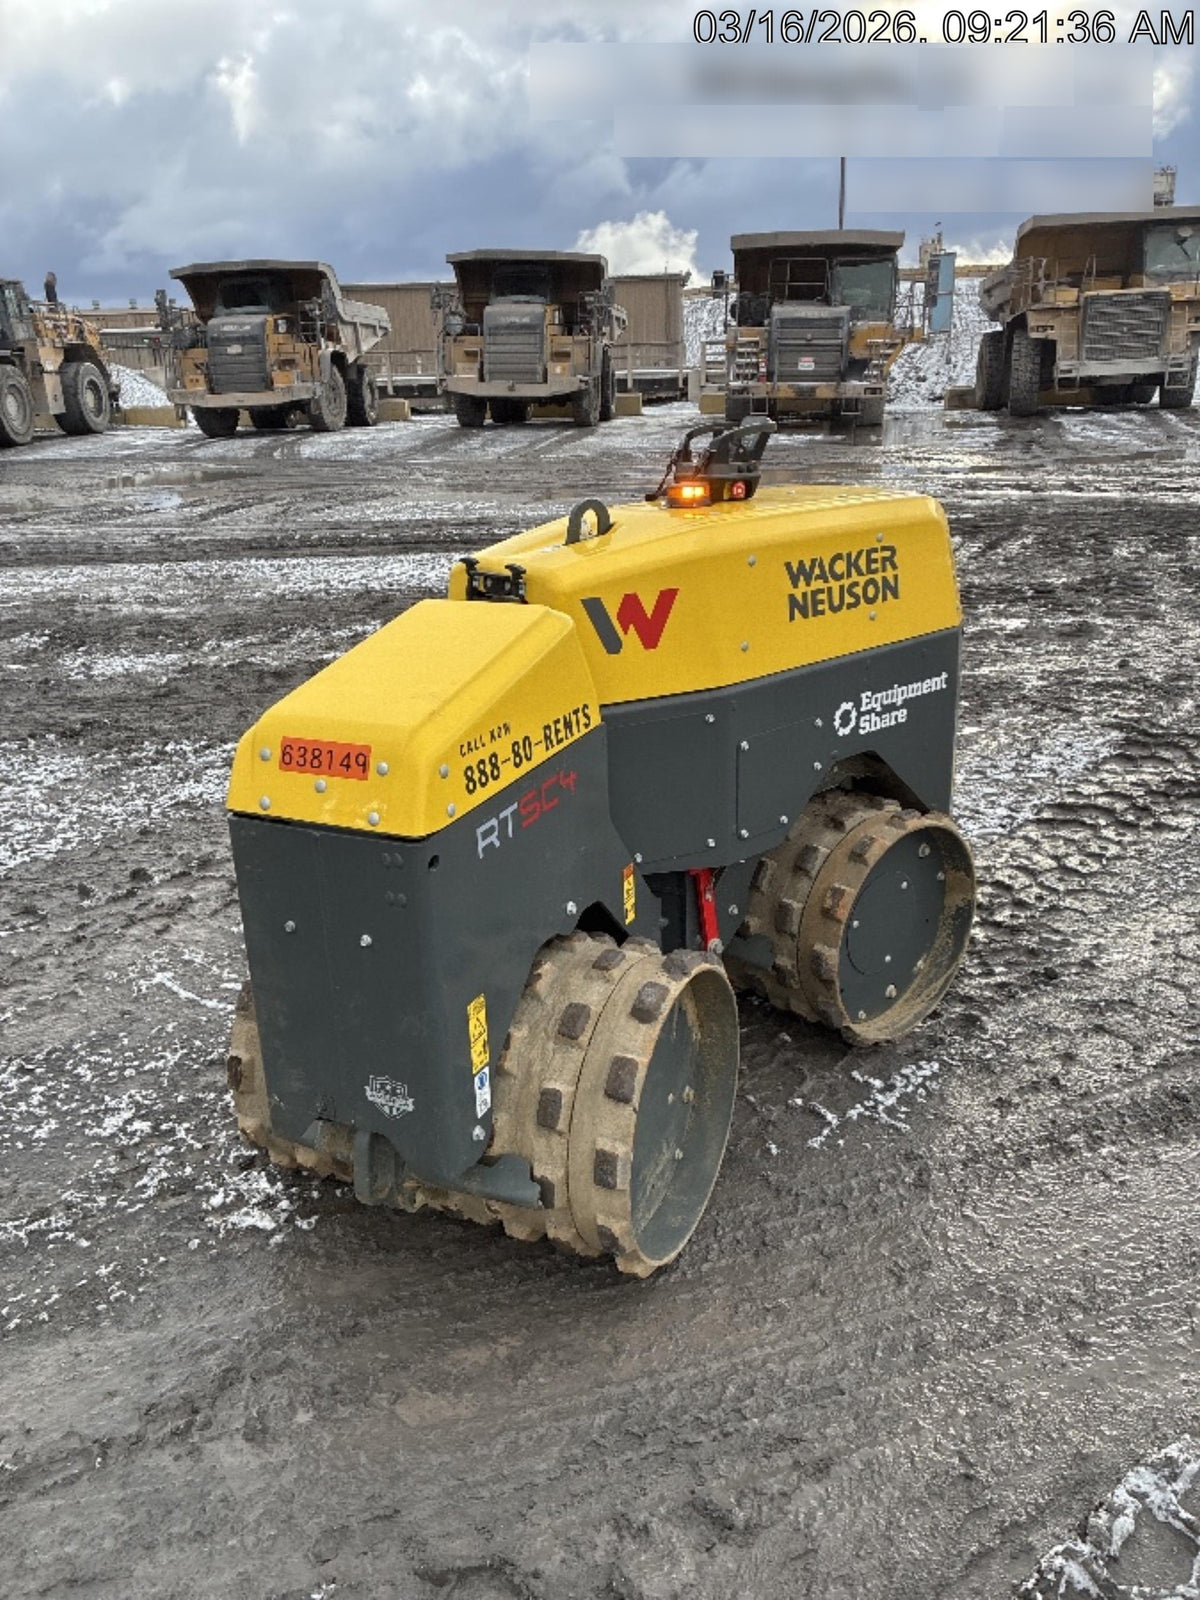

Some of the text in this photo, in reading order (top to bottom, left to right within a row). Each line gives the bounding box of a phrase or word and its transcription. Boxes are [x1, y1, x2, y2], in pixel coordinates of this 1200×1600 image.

[784, 545, 898, 589] WACKER
[788, 574, 899, 623] NEUSON
[860, 671, 948, 712] Equipment
[858, 708, 907, 735] Share
[282, 744, 367, 774] 638149
[460, 735, 486, 758] CALL
[464, 703, 591, 795] 888-80-RENTS
